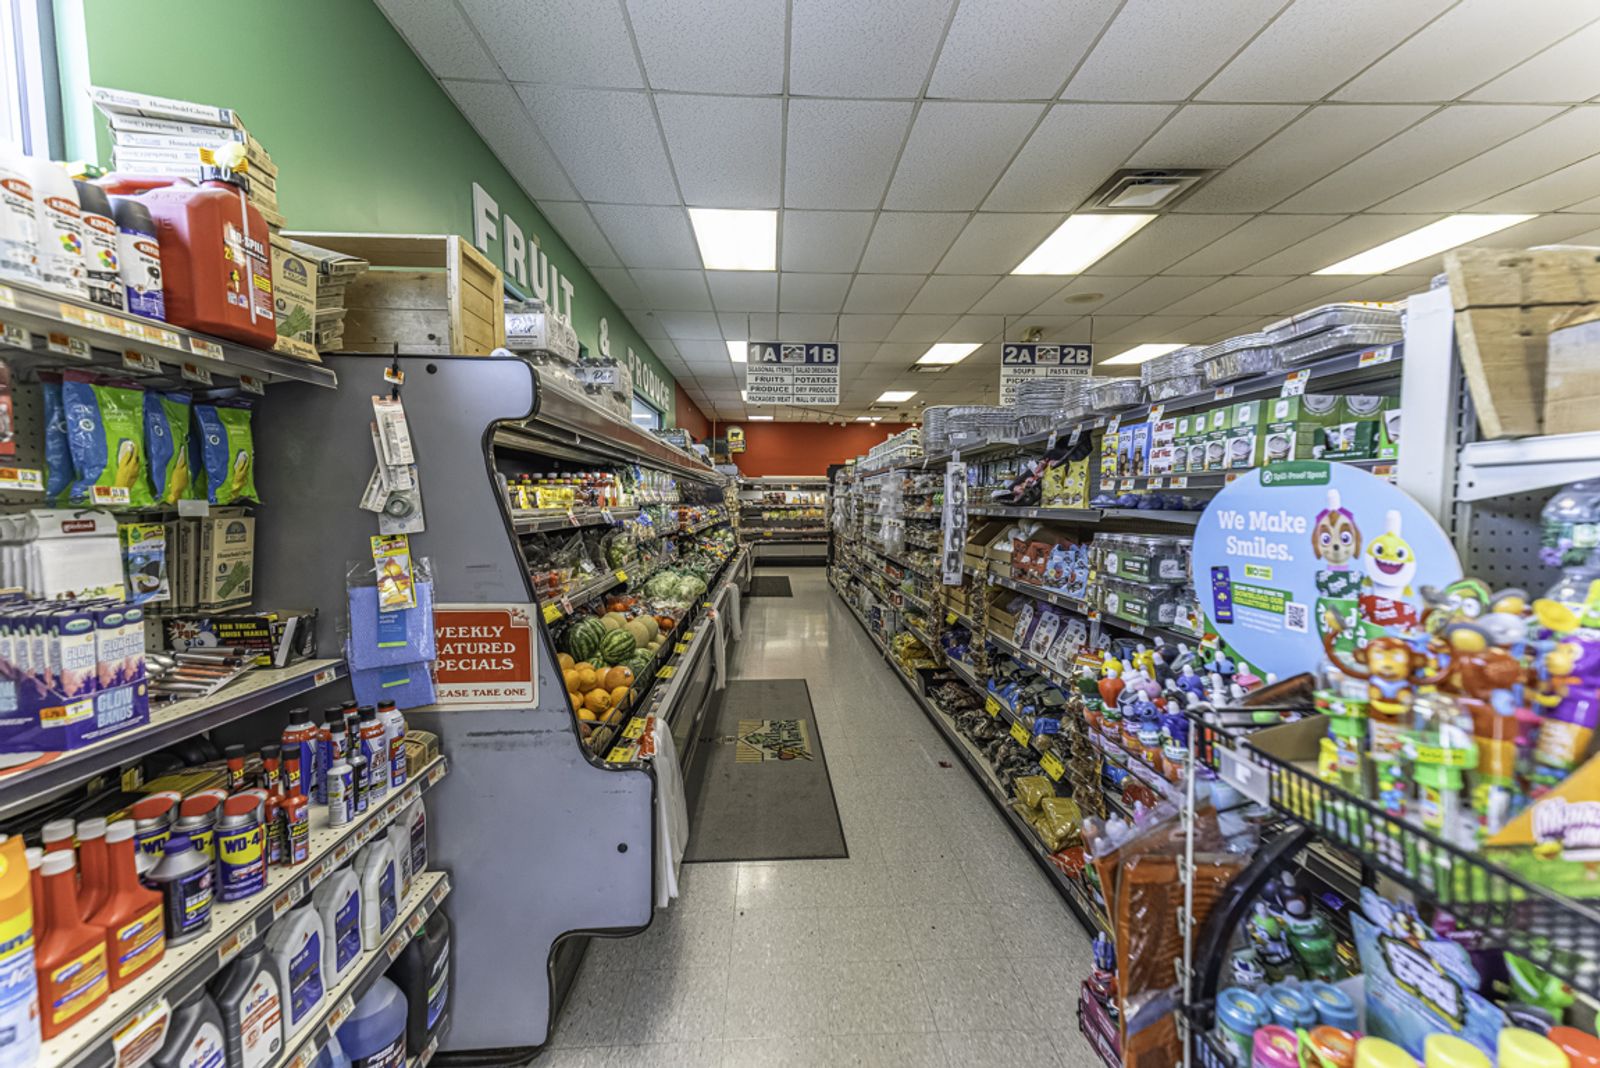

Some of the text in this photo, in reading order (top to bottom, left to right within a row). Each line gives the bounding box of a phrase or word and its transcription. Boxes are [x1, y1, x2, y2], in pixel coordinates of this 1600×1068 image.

[472, 181, 670, 411] FRUIT & PRODUCE
[750, 344, 836, 362] 1A 1B
[1004, 346, 1090, 364] 2A 2B
[1217, 510, 1307, 534] We Make
[1226, 535, 1294, 562] Smiles.
[436, 642, 516, 655] ATURED
[434, 658, 515, 671] PECIALS
[98, 686, 133, 709] GLOW
[440, 688, 527, 697] EASE TAKE ONE
[98, 704, 133, 728] BANDS
[224, 831, 260, 855] WD-4
